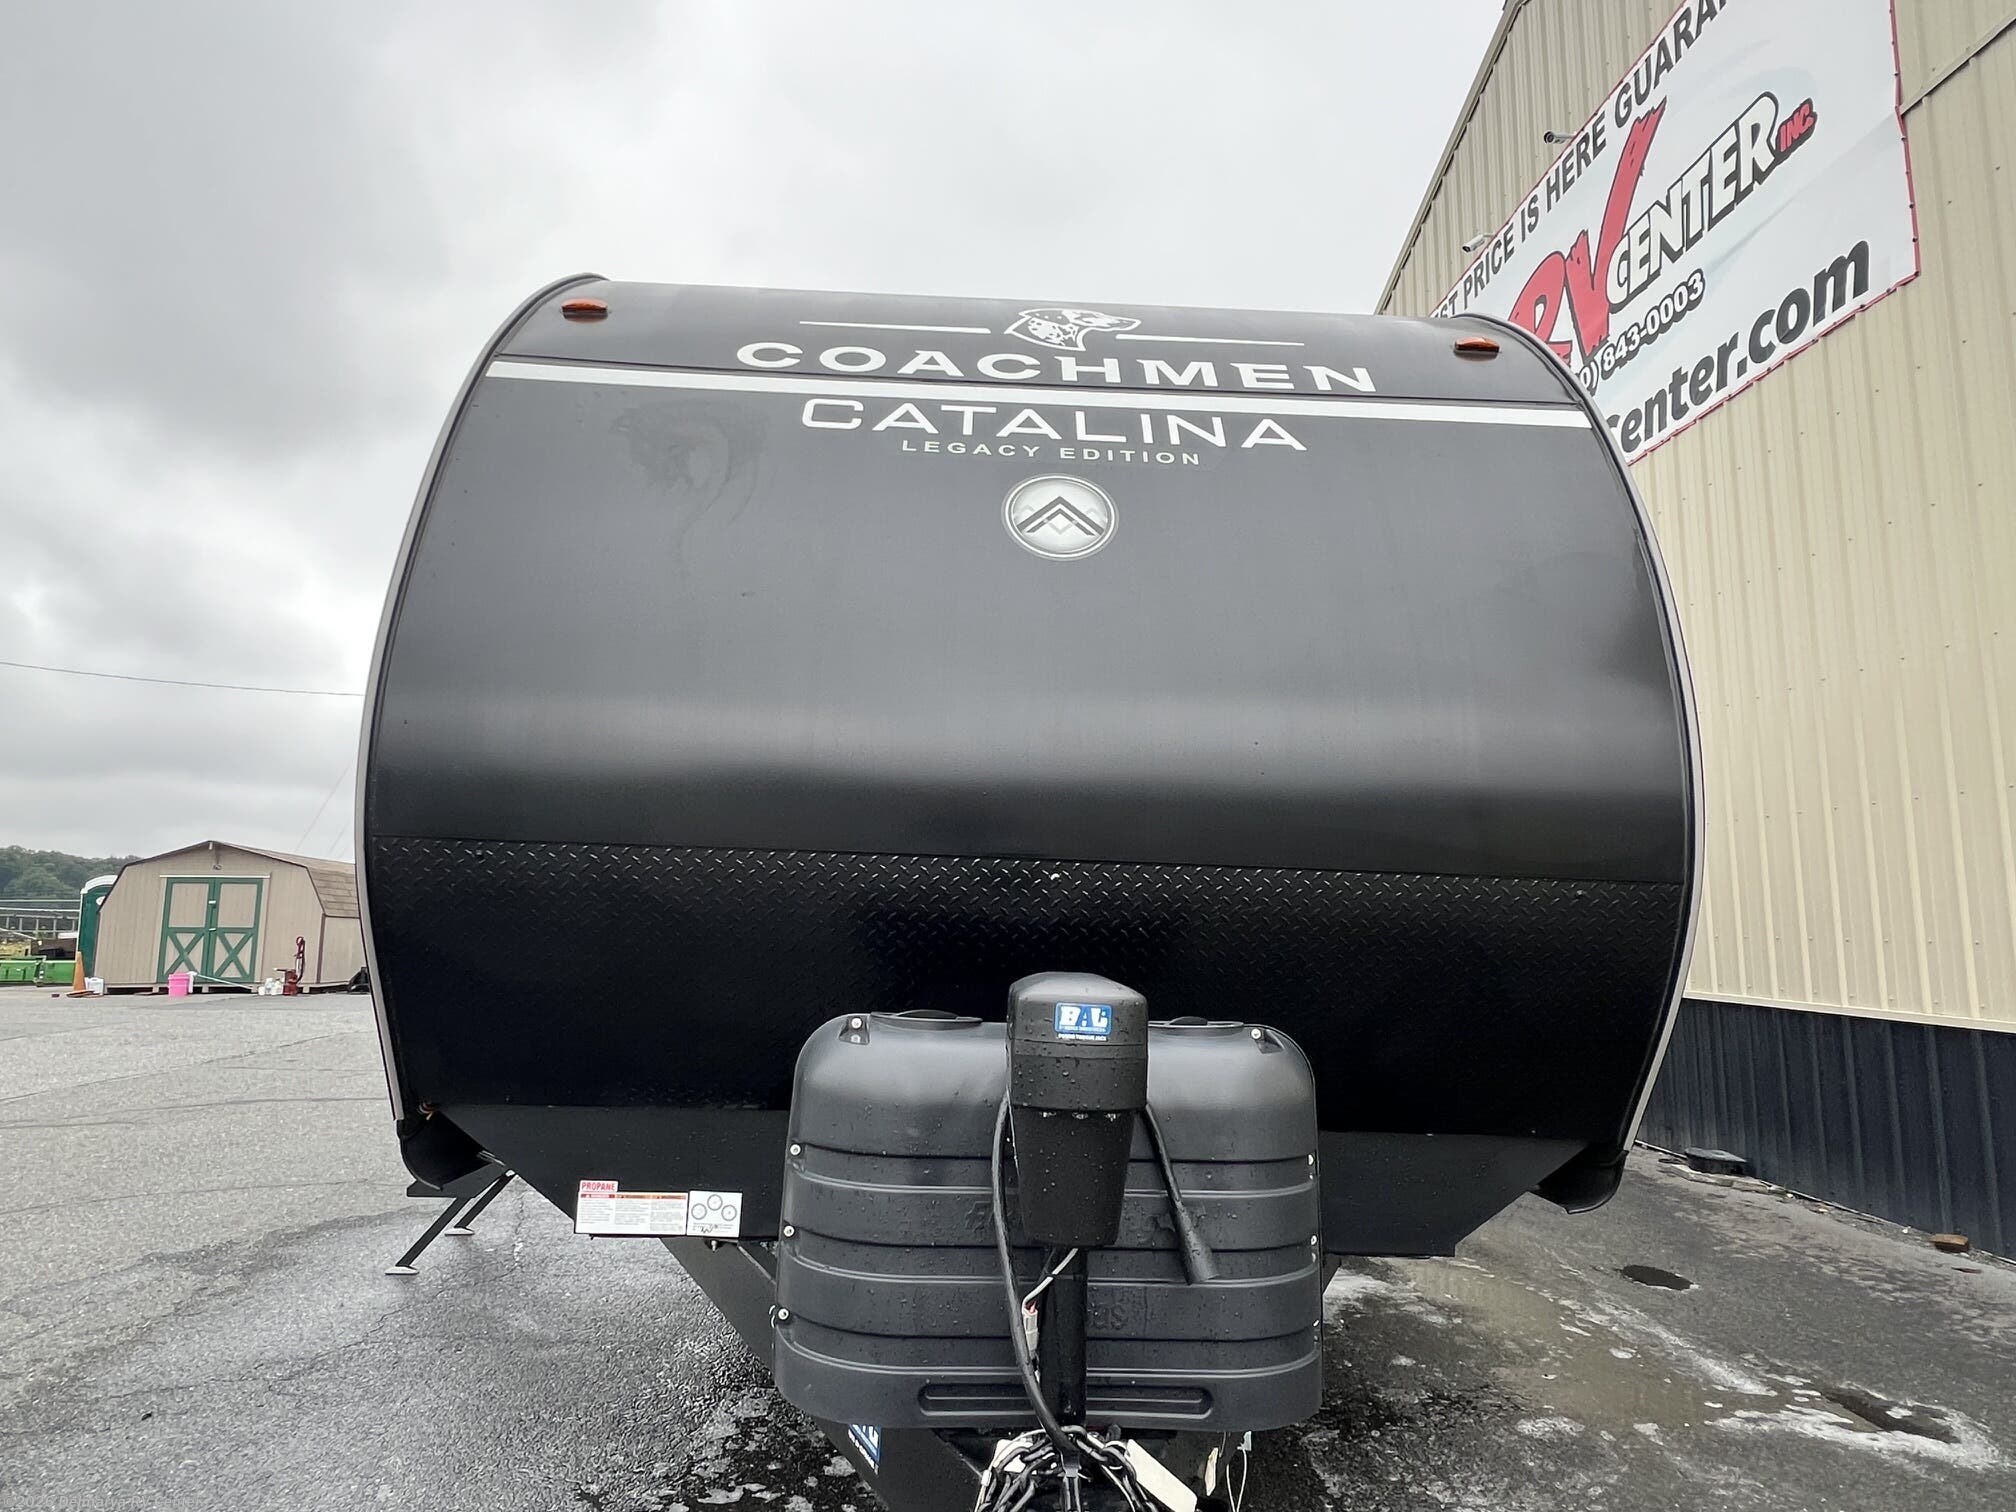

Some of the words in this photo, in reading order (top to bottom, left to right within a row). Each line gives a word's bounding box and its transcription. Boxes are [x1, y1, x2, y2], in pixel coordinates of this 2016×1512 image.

[1464, 223, 1515, 310] PRICE
[1521, 194, 1540, 243] IS
[1546, 111, 1607, 213] HERE
[1615, 0, 1727, 128] GUARA
[1508, 95, 1668, 368] RV
[1606, 91, 1779, 314] CENTER
[1600, 268, 1706, 380] 843-0003
[736, 342, 1377, 392] COACHMEN
[801, 398, 1308, 451] CATALINA
[902, 439, 1042, 458] LEGACY
[1059, 446, 1200, 465] EDITION
[581, 1182, 616, 1192] PROPANE
